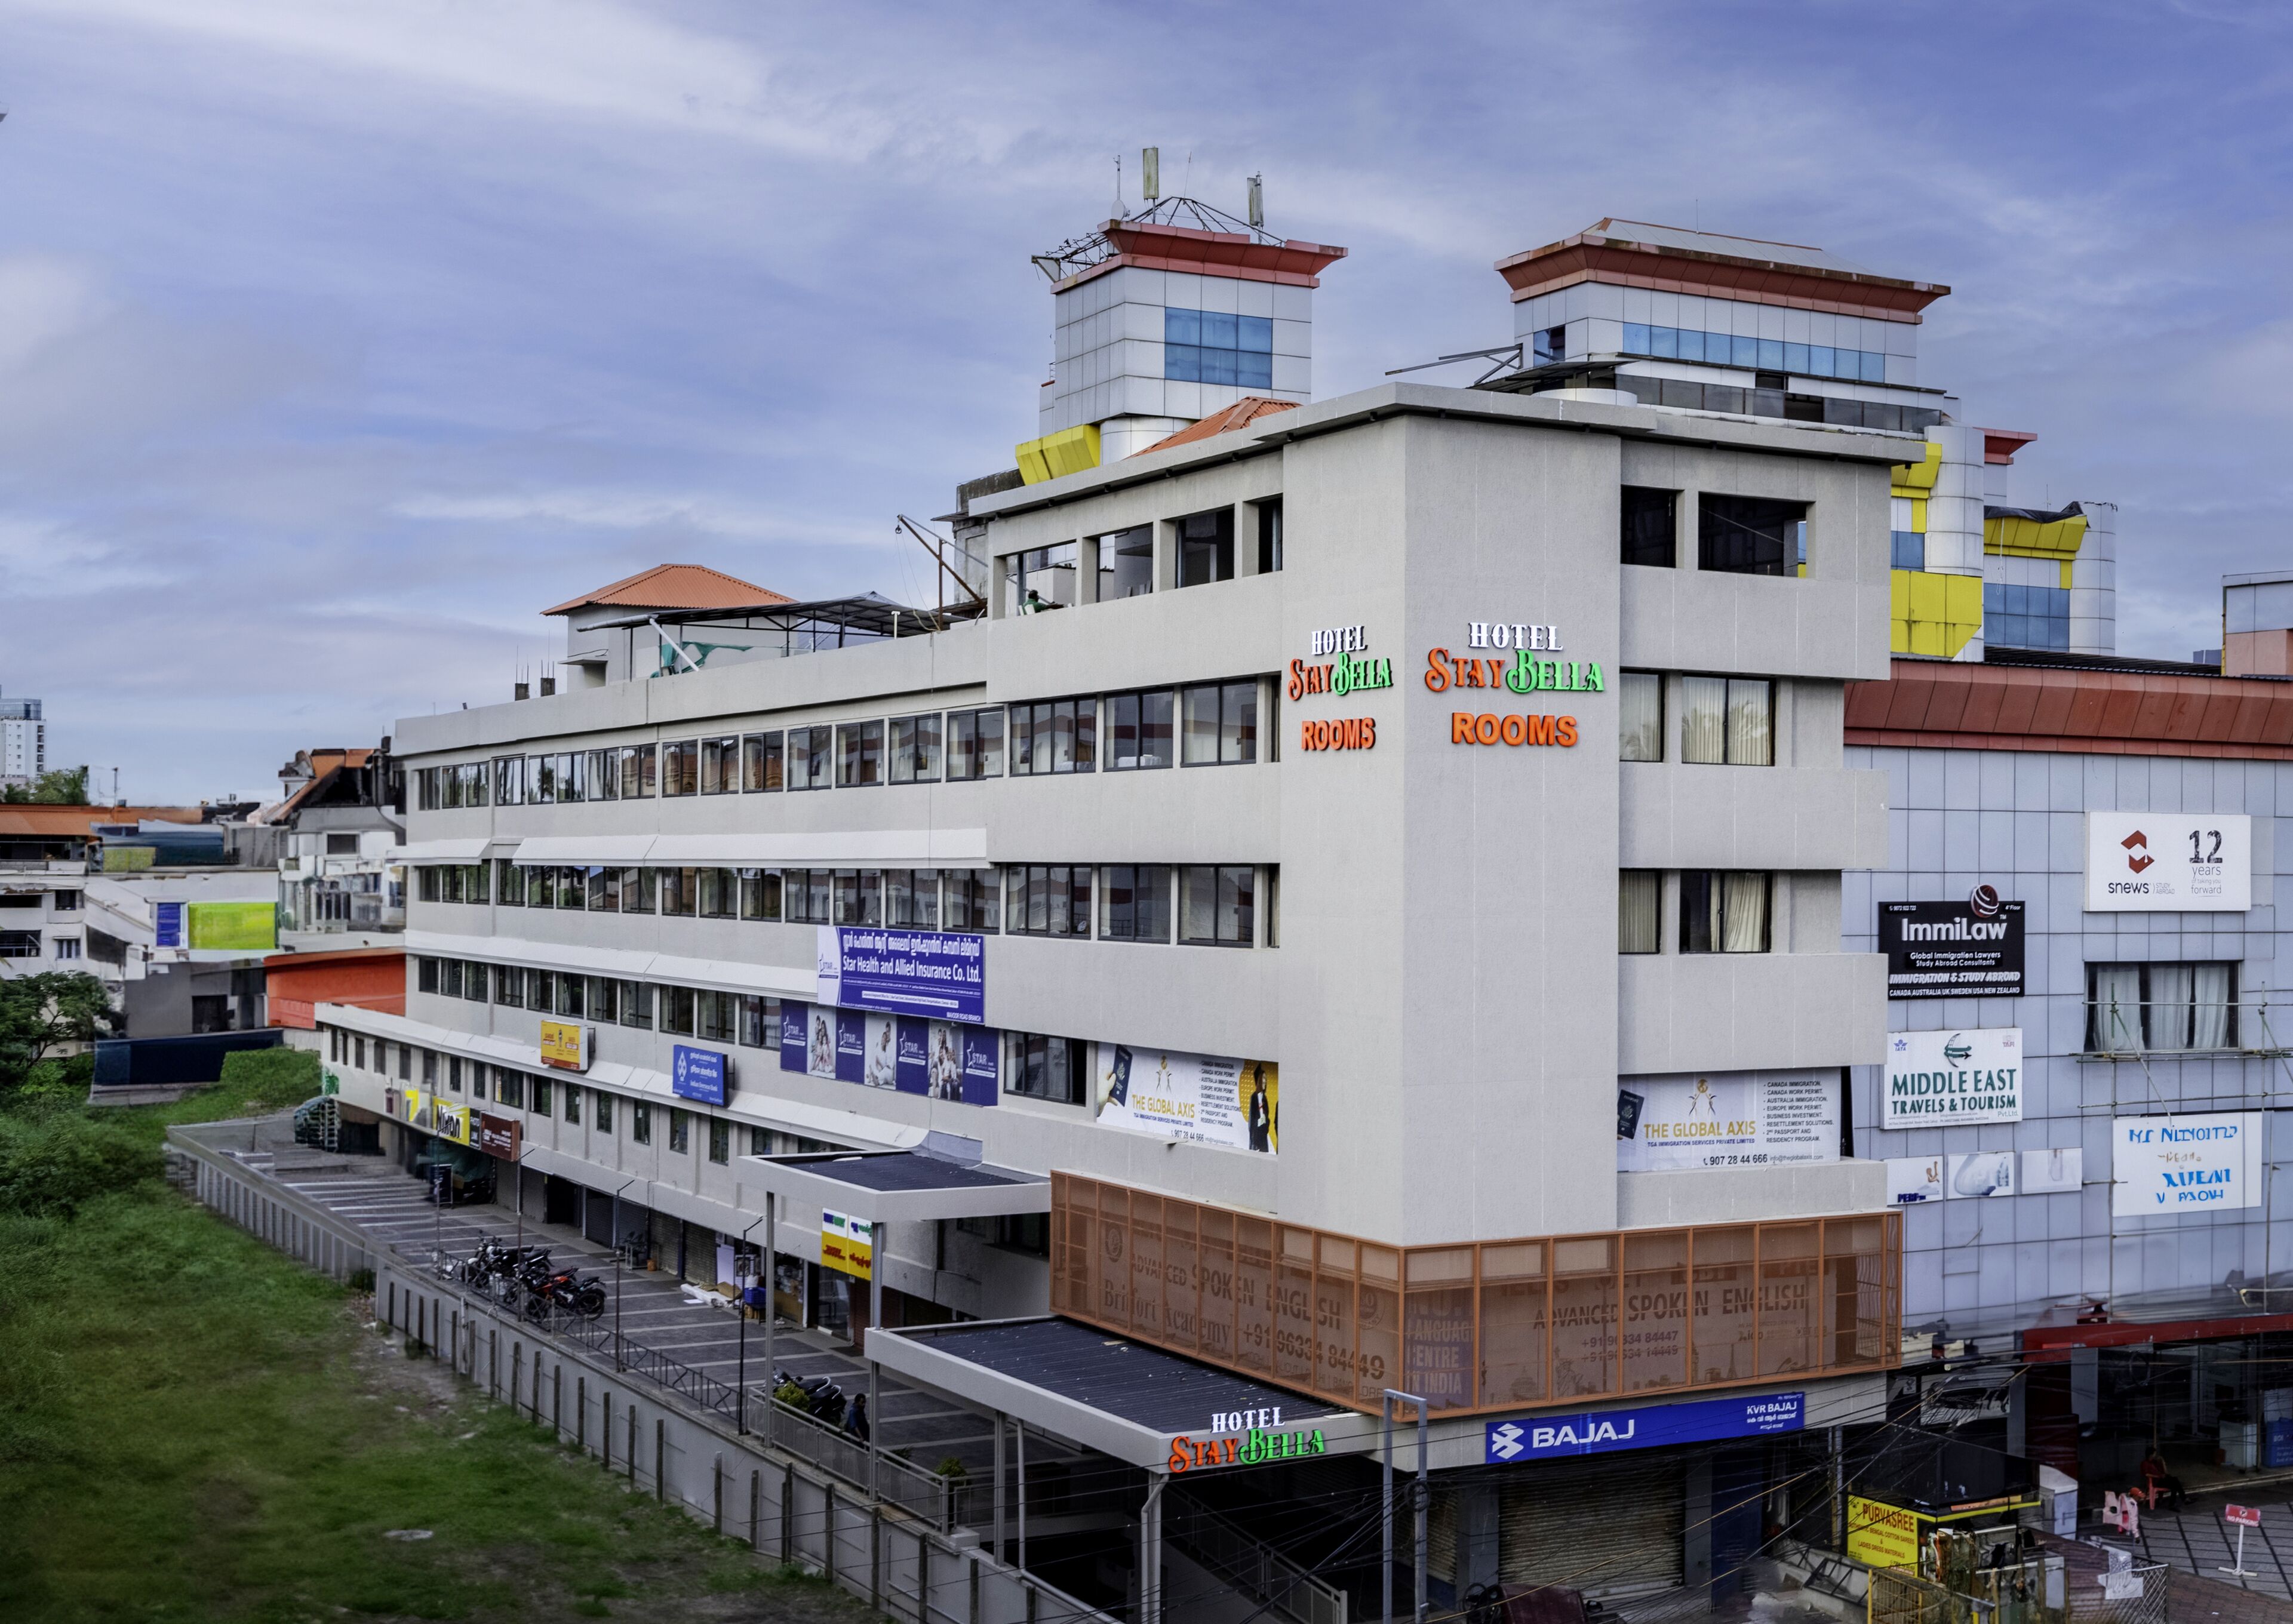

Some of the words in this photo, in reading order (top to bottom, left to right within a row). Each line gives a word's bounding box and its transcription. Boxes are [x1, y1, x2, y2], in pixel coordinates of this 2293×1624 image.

[1311, 626, 1367, 655] HOTEL
[1468, 622, 1563, 651] HOTEL
[1301, 718, 1376, 751] ROOMS
[1452, 712, 1578, 747] ROOMS
[2190, 830, 2223, 863] 12
[2192, 866, 2221, 879] years
[2108, 882, 2150, 894] snews
[2191, 885, 2221, 894] forward
[1901, 917, 2007, 941] ImmiLaw
[1934, 952, 1973, 960] Immigration
[843, 955, 856, 971] Star
[857, 956, 880, 973] Health
[880, 958, 893, 974] and
[895, 958, 915, 976] Allied
[917, 961, 951, 980] Insurance
[952, 964, 965, 981] Co.
[967, 965, 981, 983] Ltd.
[1889, 973, 1950, 984] IMMIGRATION
[1950, 973, 1957, 982] &
[1958, 972, 1985, 982] STUDY
[1985, 971, 2021, 982] ABROAD
[788, 1025, 799, 1035] STAR
[843, 1033, 856, 1044] STAR
[905, 1042, 918, 1053] STAR
[972, 1053, 987, 1065] STAR
[1892, 1071, 1967, 1096] MIDDLE
[1974, 1069, 2017, 1092] EAST
[1132, 1094, 1145, 1110] THE
[1148, 1097, 1175, 1115] GLOBAL
[1177, 1102, 1195, 1118] AXIS
[1892, 1098, 1945, 1115] TRAVELS
[1949, 1098, 1957, 1111] &
[1960, 1095, 2016, 1111] TOURISM
[1644, 1123, 1668, 1139] THE
[1673, 1122, 1723, 1137] GLOBAL
[1727, 1121, 1756, 1136] AXIS
[1710, 1157, 1725, 1165] 907
[1728, 1155, 1738, 1164] 28
[1740, 1155, 1750, 1164] 44
[1753, 1154, 1768, 1163] 666
[1266, 1284, 1341, 1330] ENGLSH
[1628, 1290, 1708, 1321] SPOKN
[1722, 1284, 1805, 1315] ENGLISH
[1407, 1318, 1473, 1343] LANGUAG
[1582, 1336, 1603, 1348] +91
[1645, 1331, 1679, 1343] 84447
[1244, 1322, 1270, 1348] +91
[1277, 1329, 1323, 1364] 96334
[1328, 1343, 1385, 1380] 84449
[1582, 1351, 1603, 1362] +91
[1425, 1373, 1462, 1394] INDIA
[1747, 1405, 1766, 1414] KVR
[1768, 1401, 1797, 1413] BAJAJ
[1211, 1407, 1285, 1433] HOTEL
[1533, 1419, 1634, 1448] BAJAJ
[1862, 1503, 1914, 1533] PURVASREE
[2235, 1517, 2259, 1527] PARKING
